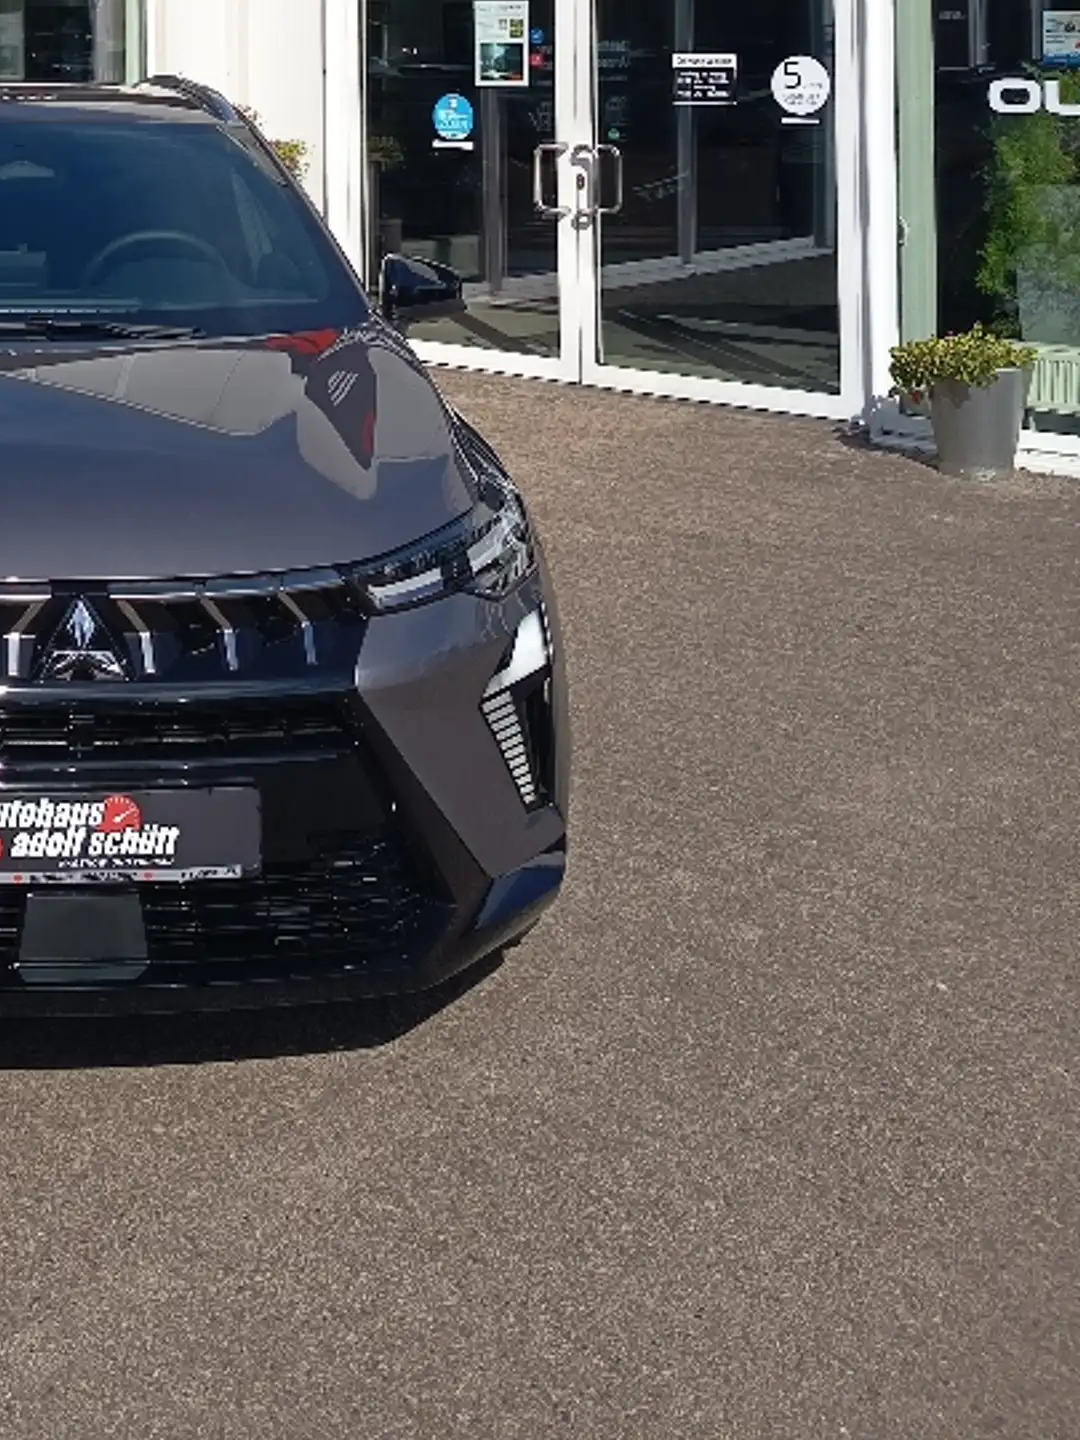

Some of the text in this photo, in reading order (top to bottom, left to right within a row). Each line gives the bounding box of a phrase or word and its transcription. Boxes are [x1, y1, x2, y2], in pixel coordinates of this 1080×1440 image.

[784, 62, 801, 89] 5
[11, 824, 180, 857] adolf schütt
